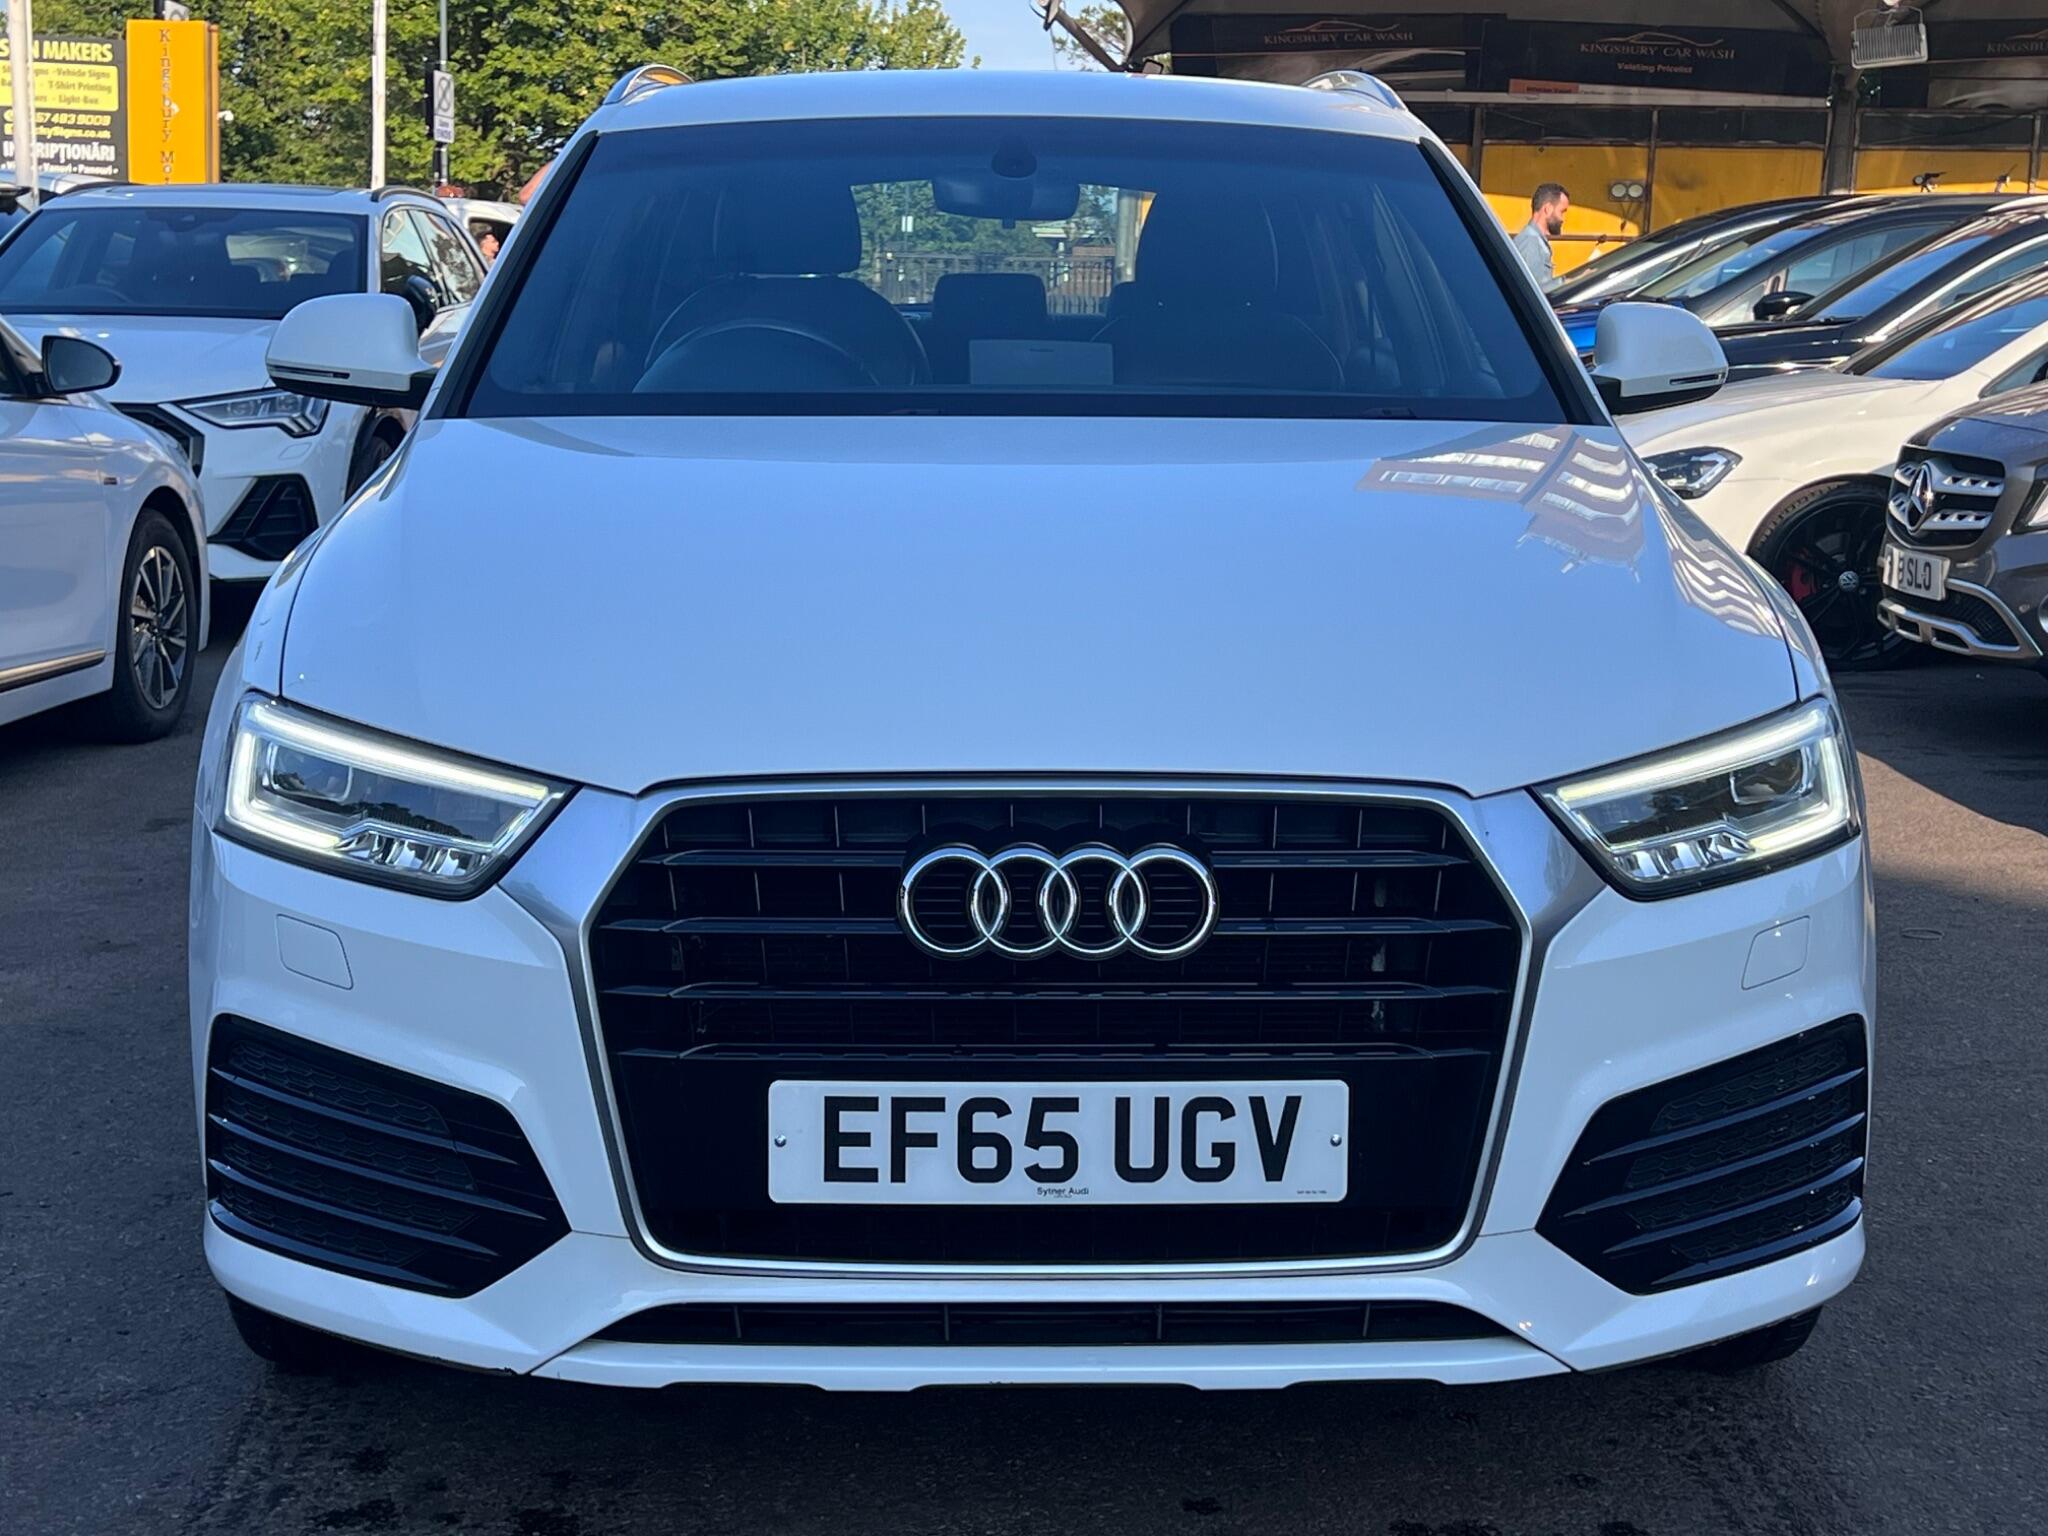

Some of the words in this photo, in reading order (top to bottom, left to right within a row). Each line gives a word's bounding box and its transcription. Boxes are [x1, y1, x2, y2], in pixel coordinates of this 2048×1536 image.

[1344, 32, 1372, 42] CAR
[1375, 31, 1413, 42] WASH
[43, 41, 113, 63] MAKERS
[1580, 43, 1658, 56] KINGSBURY
[1663, 47, 1692, 57] CAR
[1696, 49, 1736, 60] WASH
[823, 1095, 1080, 1184] EF65
[1114, 1095, 1303, 1184] UGV
[1037, 1187, 1066, 1197] Sytner
[1069, 1187, 1089, 1195] Audi
